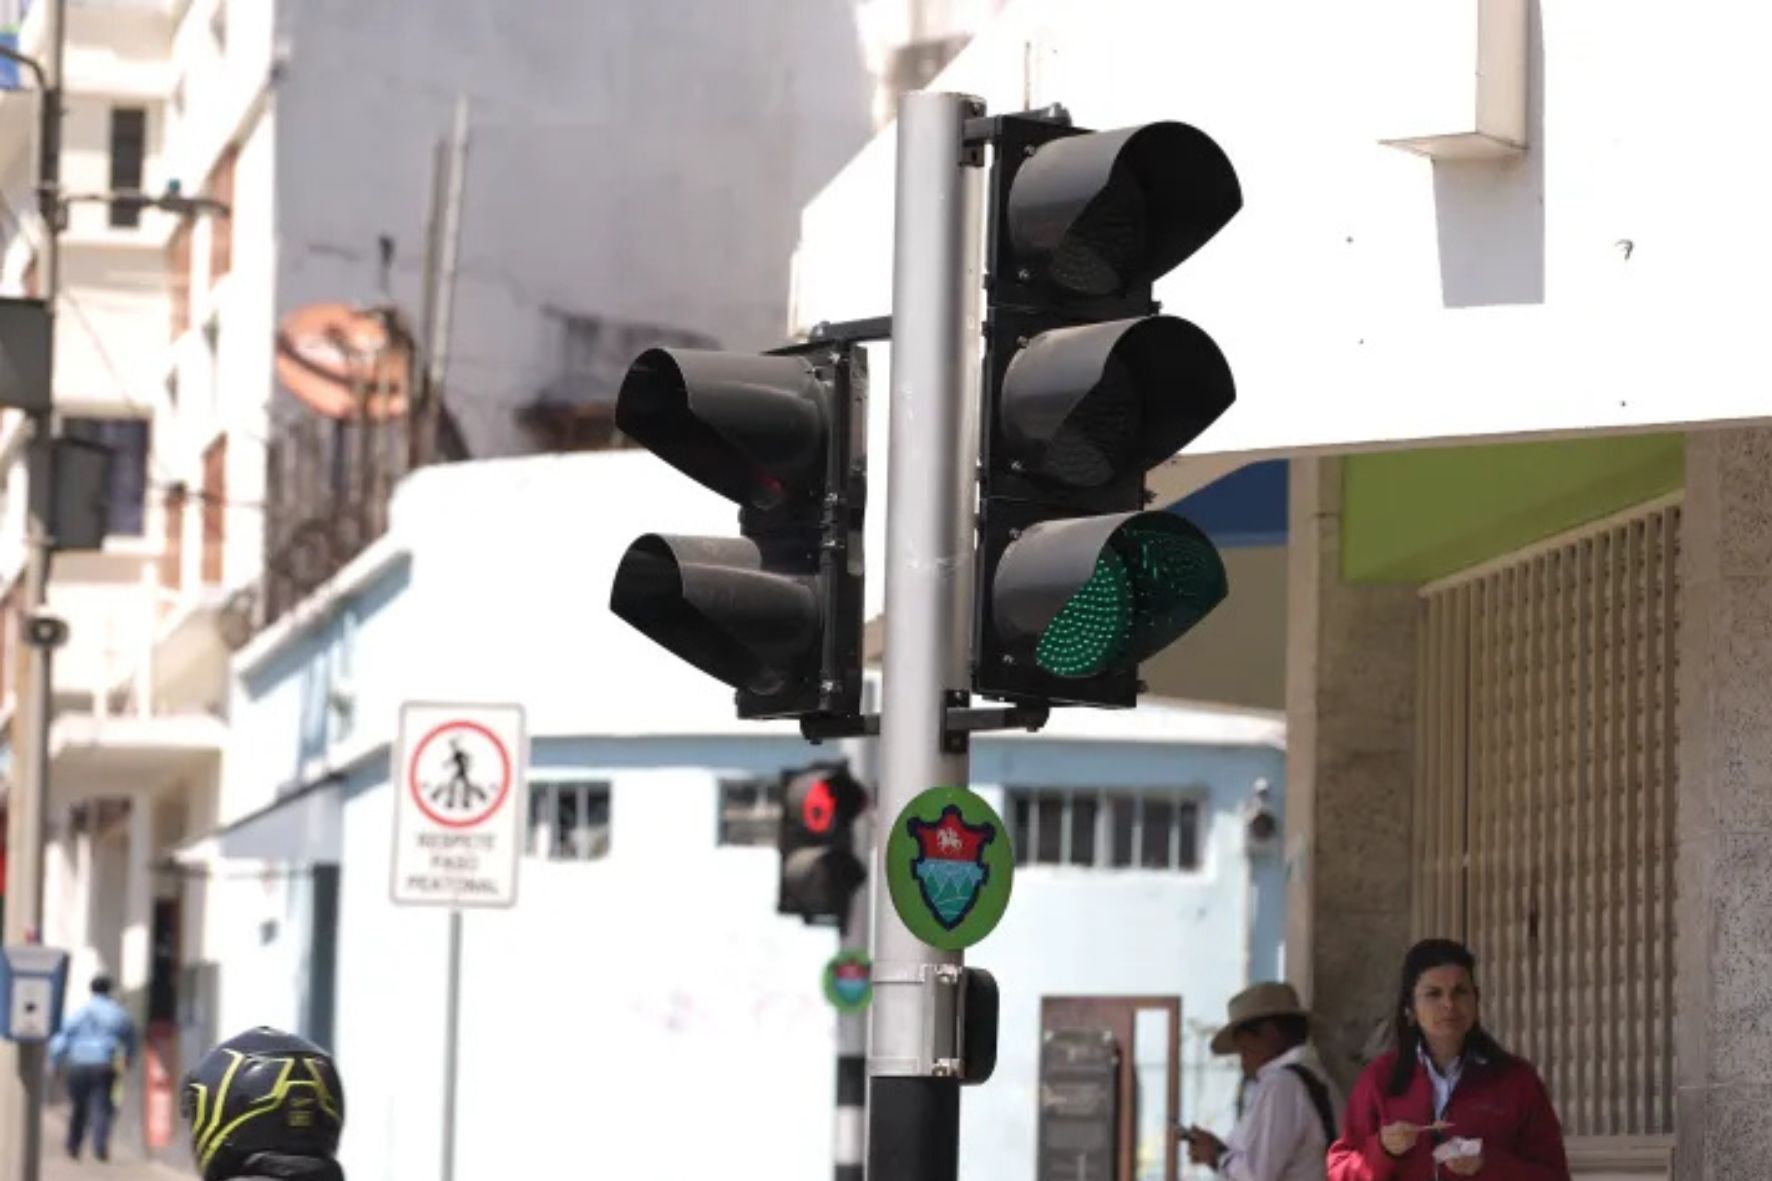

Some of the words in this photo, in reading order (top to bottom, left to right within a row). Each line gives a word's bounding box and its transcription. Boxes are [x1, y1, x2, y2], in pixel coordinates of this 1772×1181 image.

[416, 832, 496, 849] RESPETE
[430, 855, 479, 871] PASO
[407, 875, 499, 894] PEATONAL
